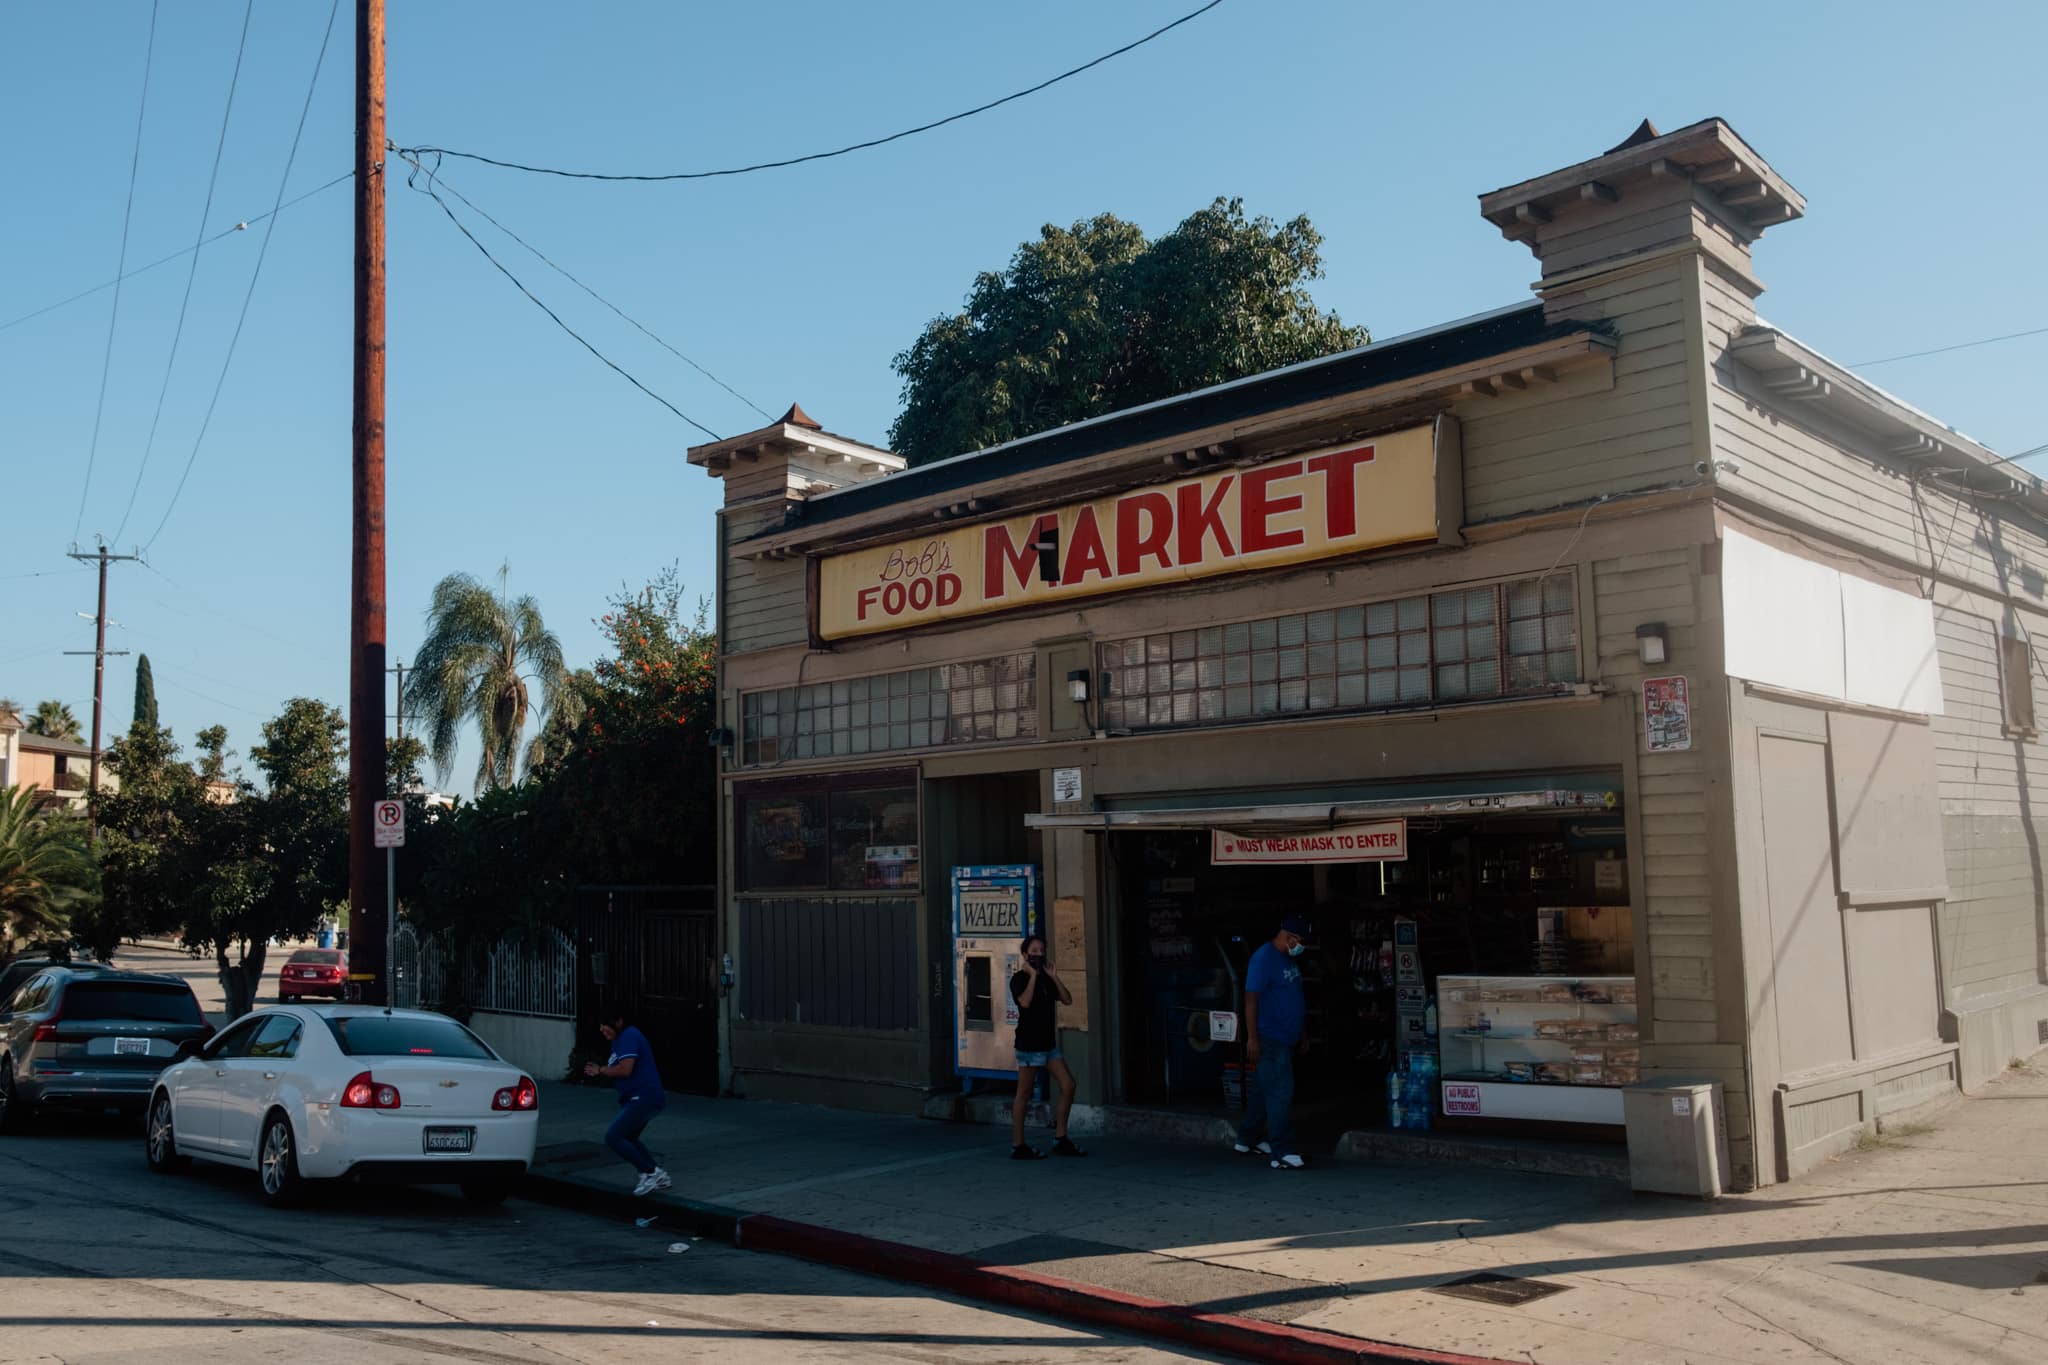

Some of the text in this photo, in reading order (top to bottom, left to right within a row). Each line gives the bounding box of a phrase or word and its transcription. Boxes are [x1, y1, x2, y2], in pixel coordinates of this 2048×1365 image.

[985, 446, 1374, 599] MARKET
[879, 541, 952, 582] Bob's
[857, 573, 962, 621] FOOD
[1236, 832, 1398, 853] MUST WEAR MASK TO ENTER
[963, 902, 1019, 927] WATER
[1458, 1087, 1476, 1099] PUBLIC
[1448, 1101, 1479, 1112] RESTROOMS
